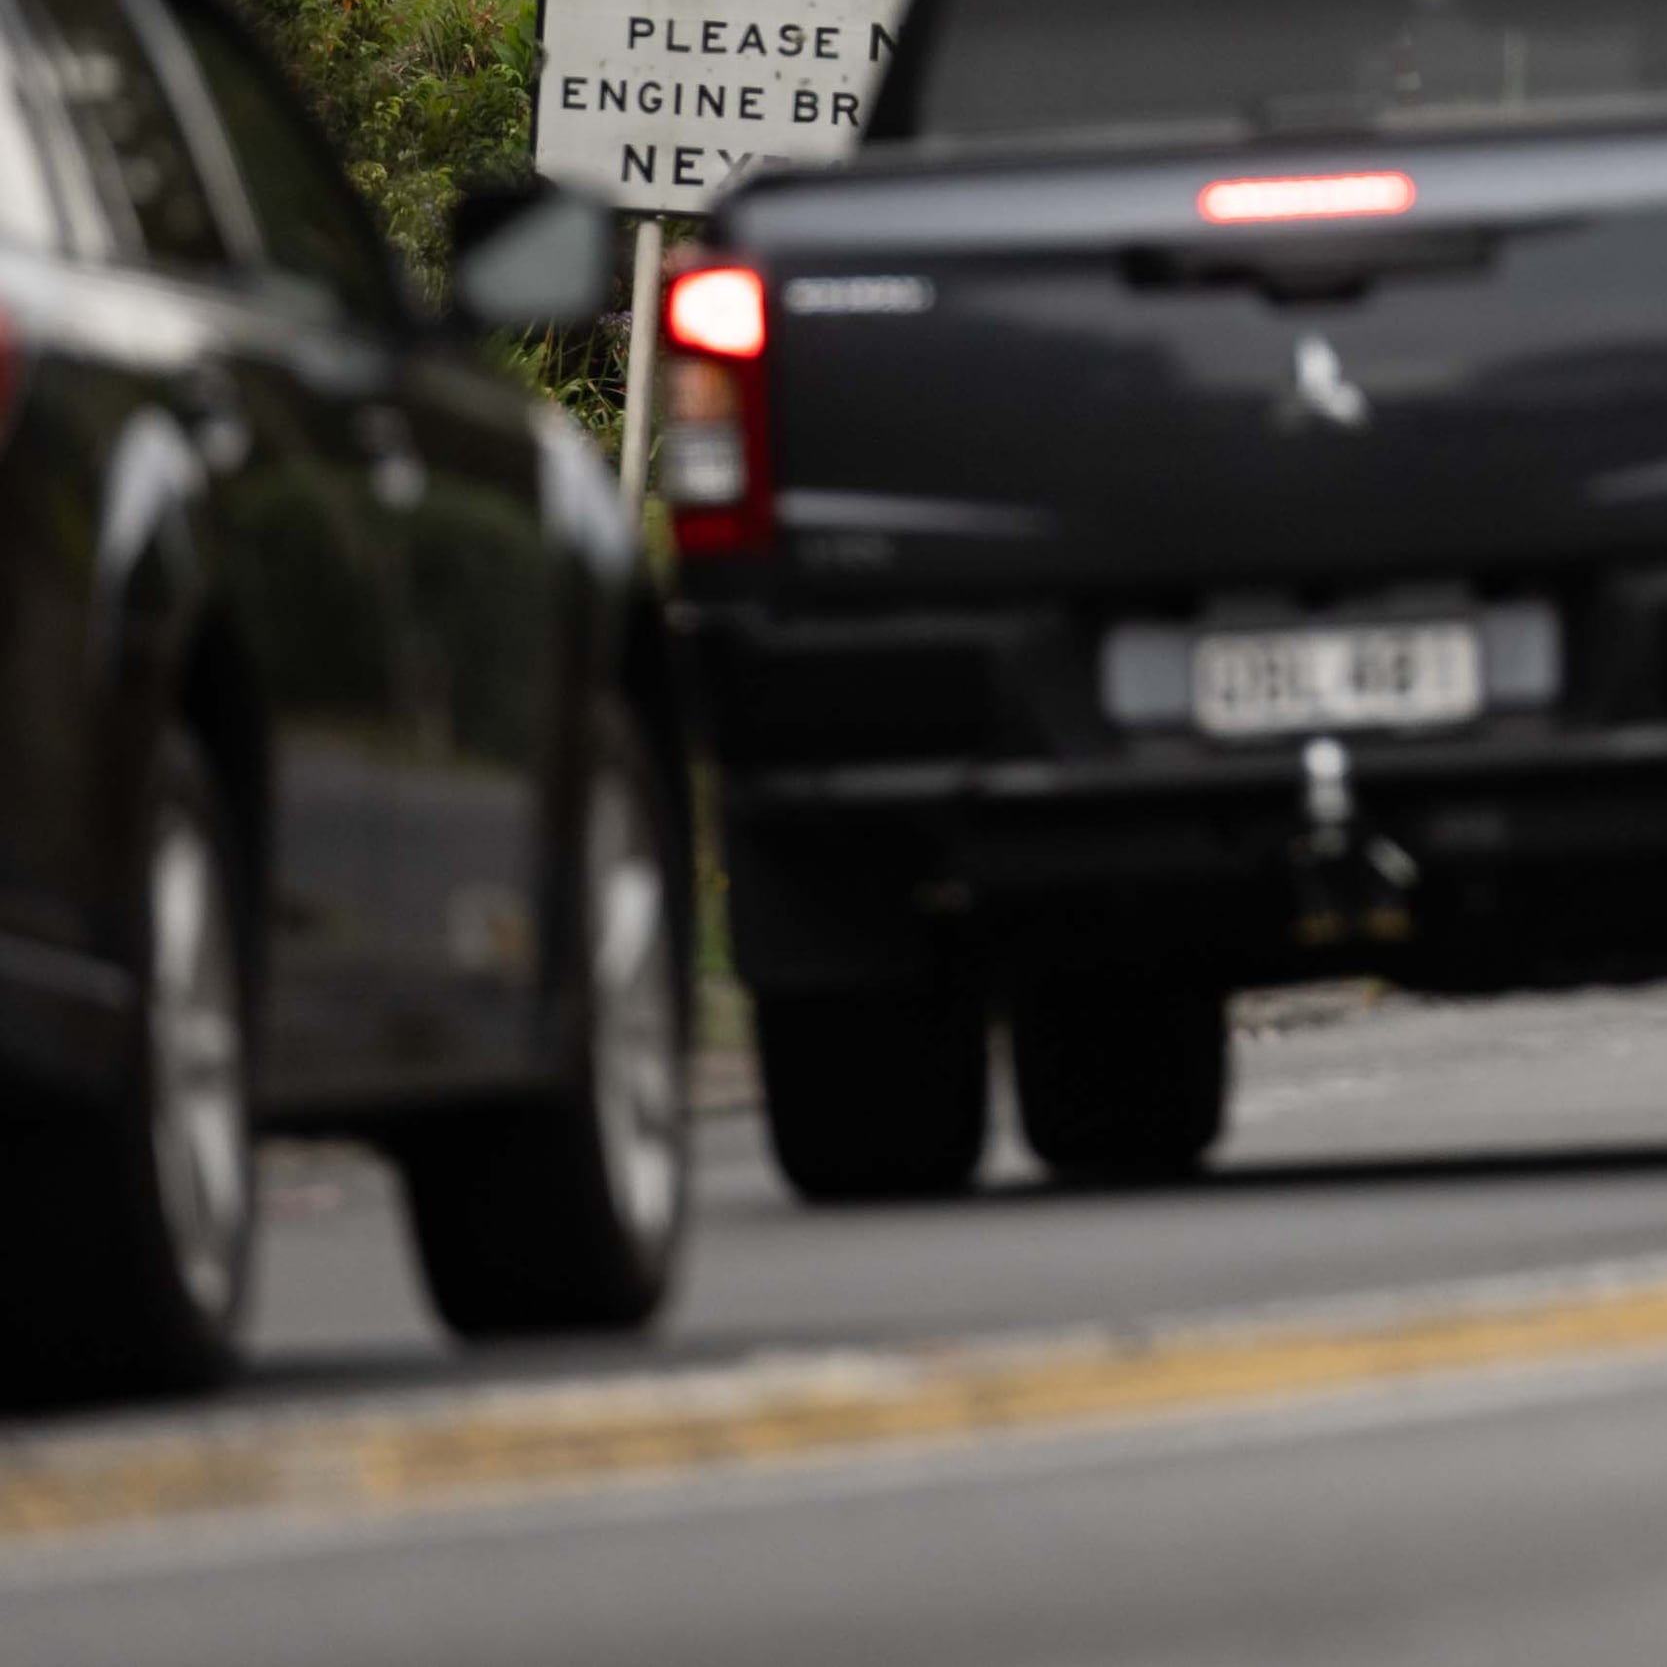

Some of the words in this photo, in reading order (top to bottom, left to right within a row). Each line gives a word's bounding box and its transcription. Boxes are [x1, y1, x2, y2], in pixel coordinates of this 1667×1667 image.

[627, 17, 841, 60] PLEASE
[562, 76, 765, 121] ENGINE
[792, 88, 860, 128] BR
